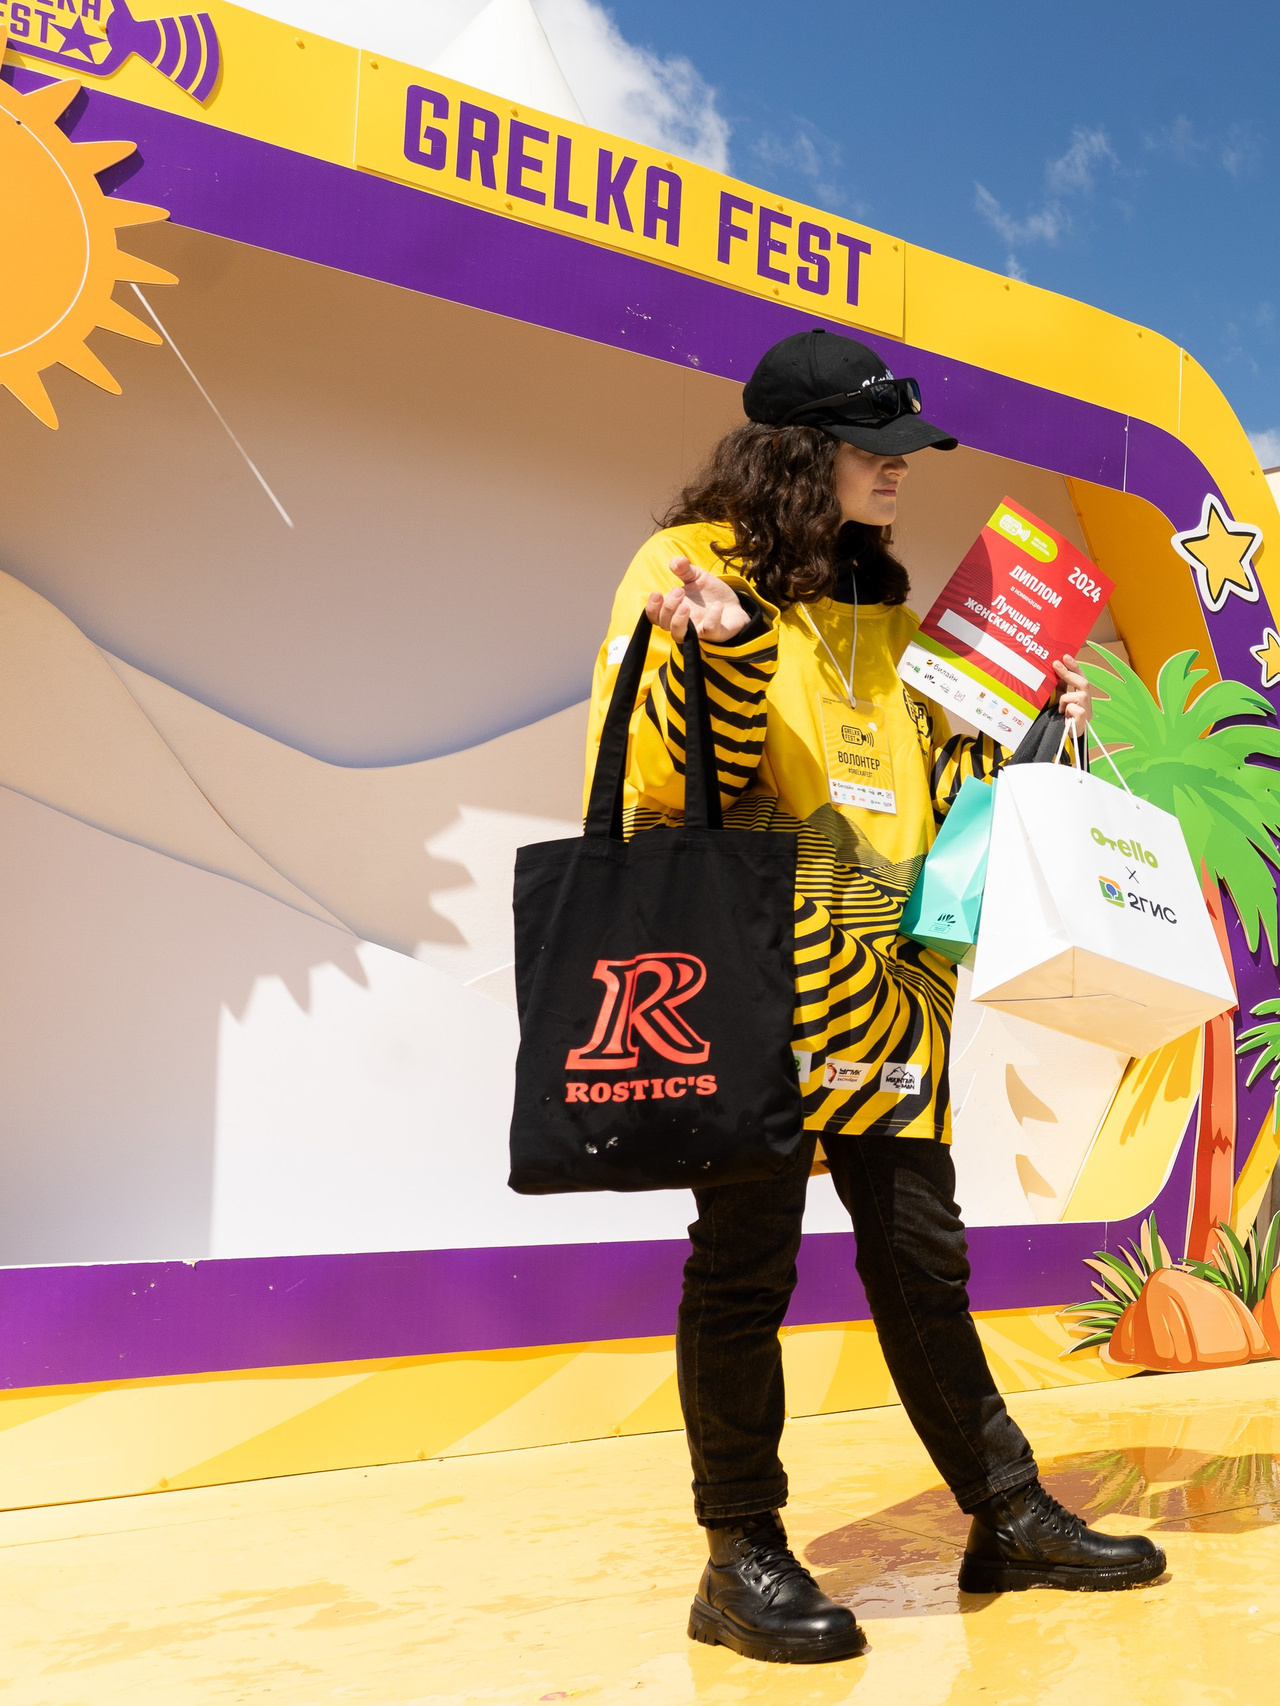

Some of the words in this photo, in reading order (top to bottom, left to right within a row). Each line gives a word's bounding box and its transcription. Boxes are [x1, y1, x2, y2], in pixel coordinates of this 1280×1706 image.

[403, 84, 682, 248] GRELKA
[717, 190, 872, 307] FEST
[1008, 564, 1063, 609] ДИПЛОМ
[1067, 566, 1102, 604] 2024
[963, 596, 1018, 638] женский
[1015, 630, 1050, 661] образ
[991, 594, 1041, 636] Лучший
[933, 663, 959, 683] билайн
[845, 733, 856, 742] FEST
[837, 750, 881, 771] ВОЛОНТЕР
[1127, 892, 1178, 925] 2ГИС
[565, 1074, 718, 1104] ROSTIC'S
